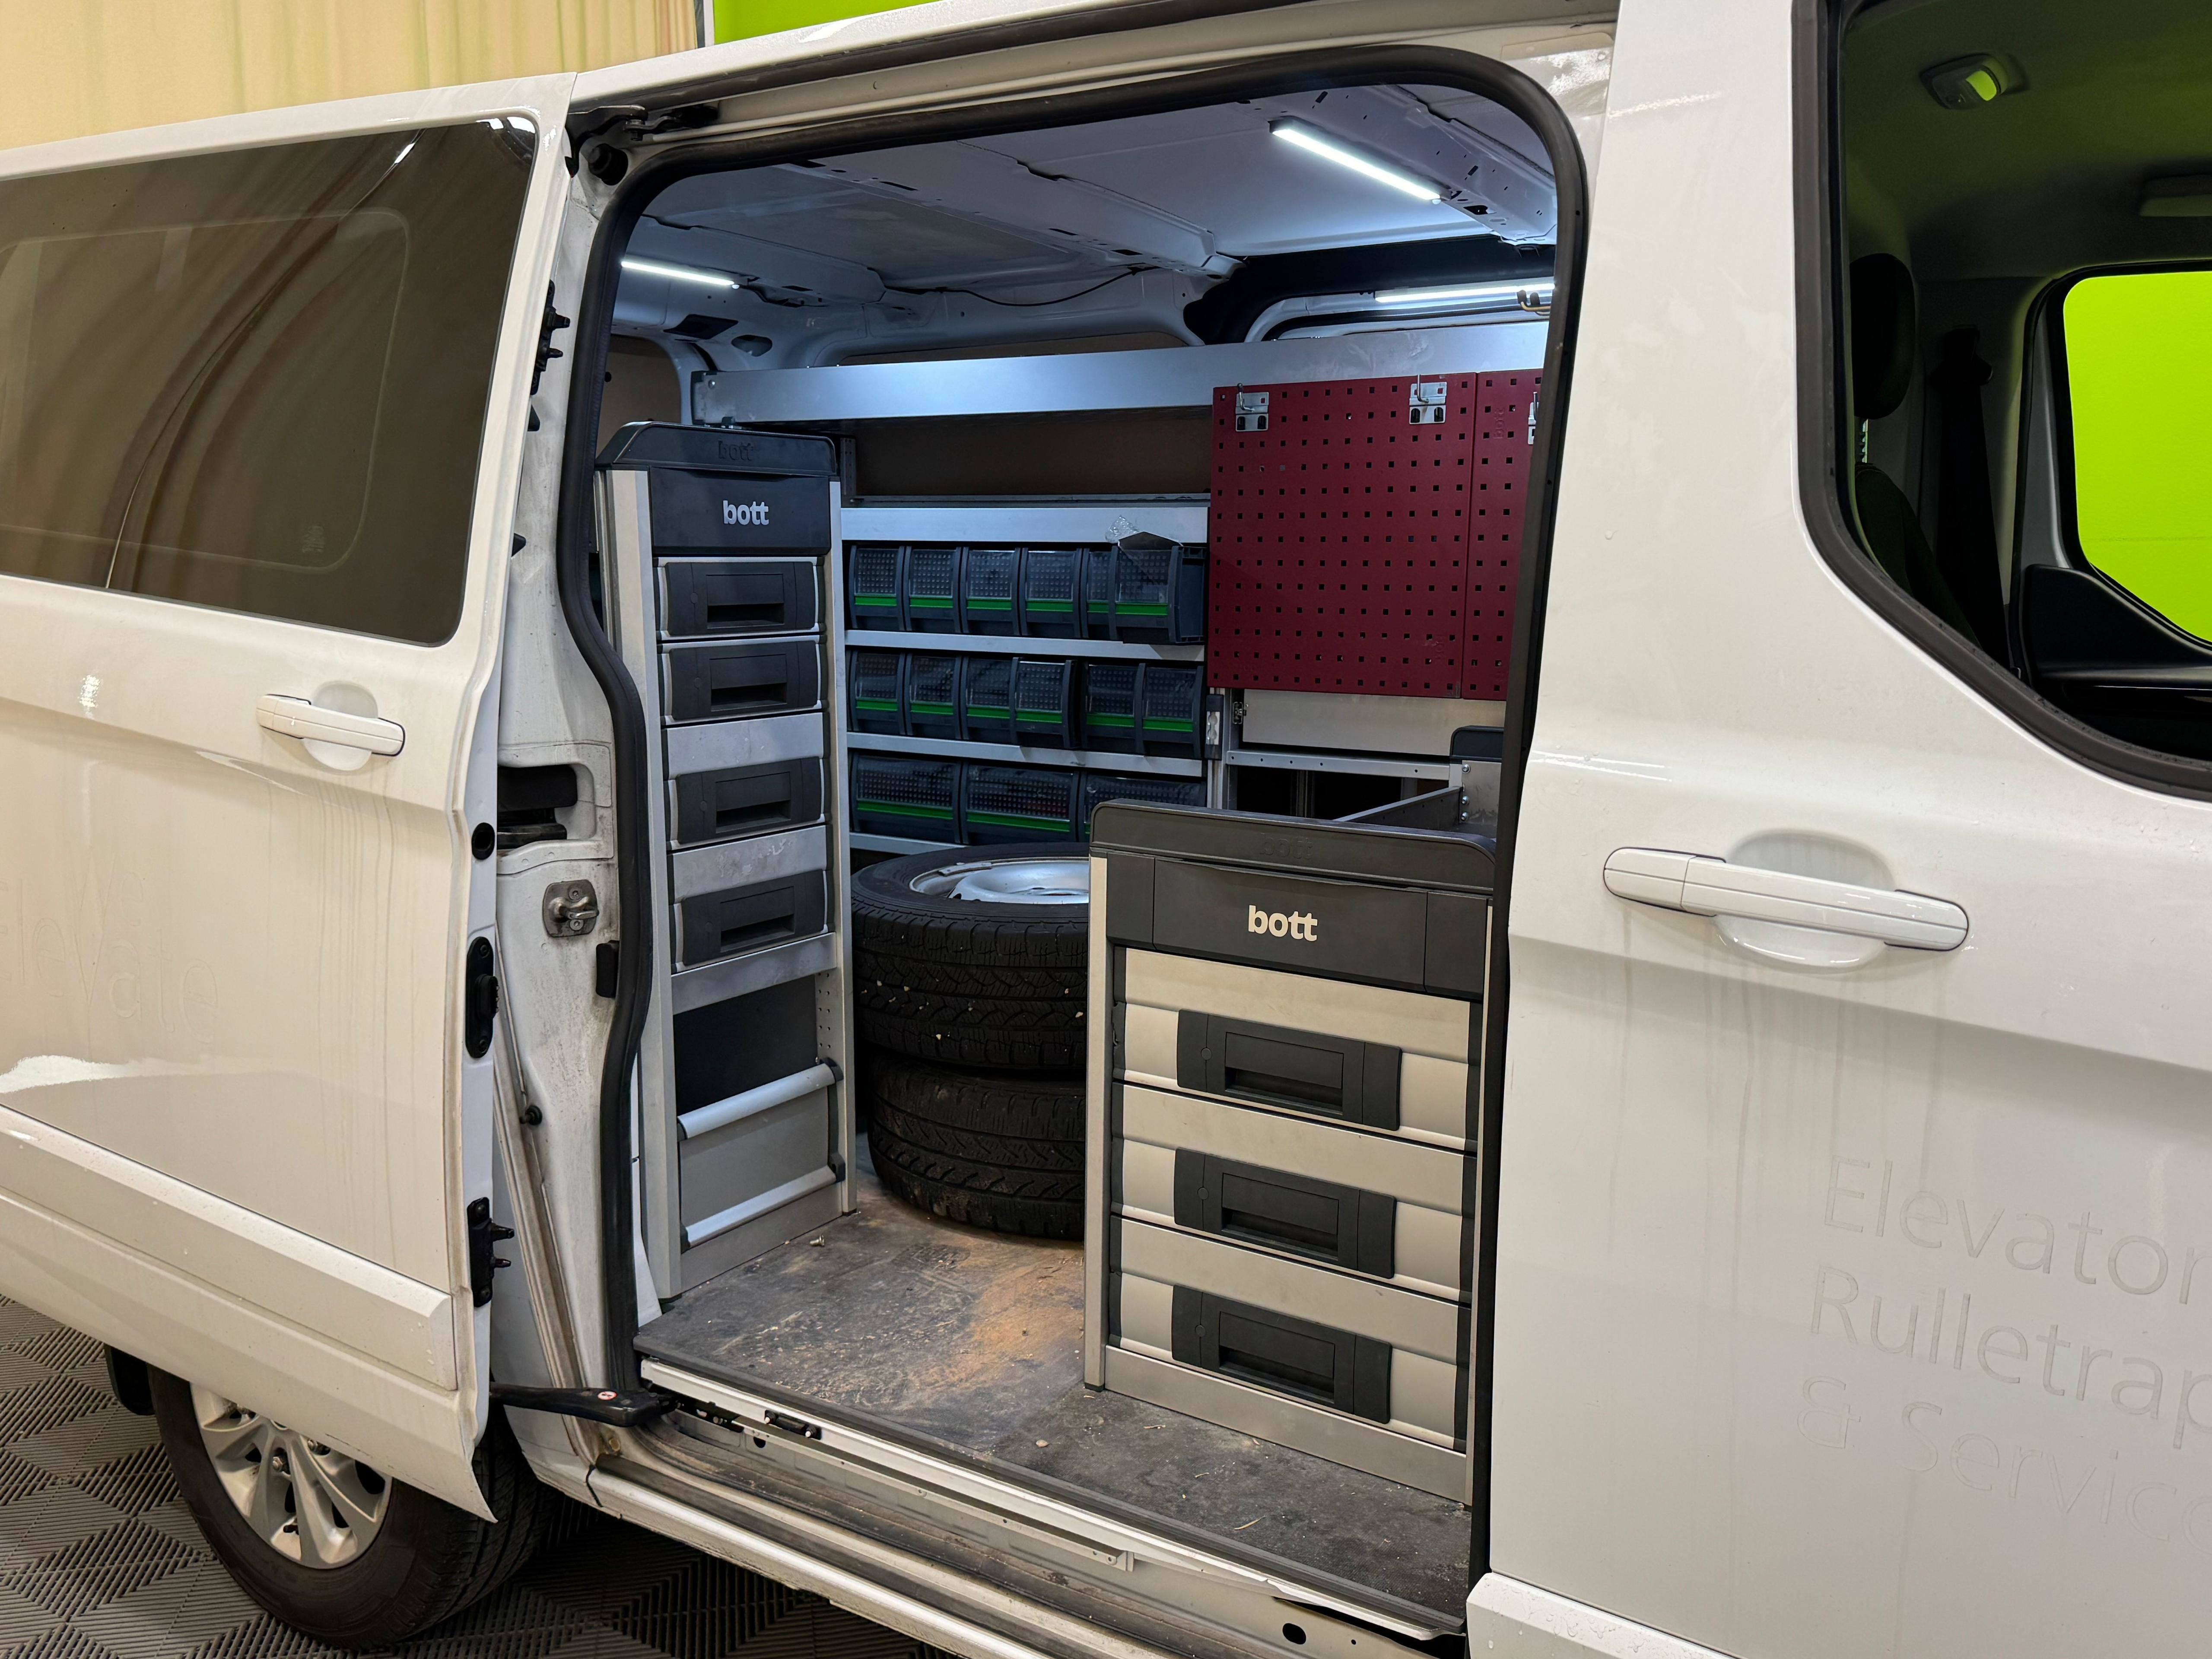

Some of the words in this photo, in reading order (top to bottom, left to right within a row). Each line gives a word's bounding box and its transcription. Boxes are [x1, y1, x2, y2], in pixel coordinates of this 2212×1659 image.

[718, 439, 754, 462] bott
[723, 500, 769, 525] bott
[1259, 832, 1313, 861] bott
[1248, 904, 1318, 942] bott
